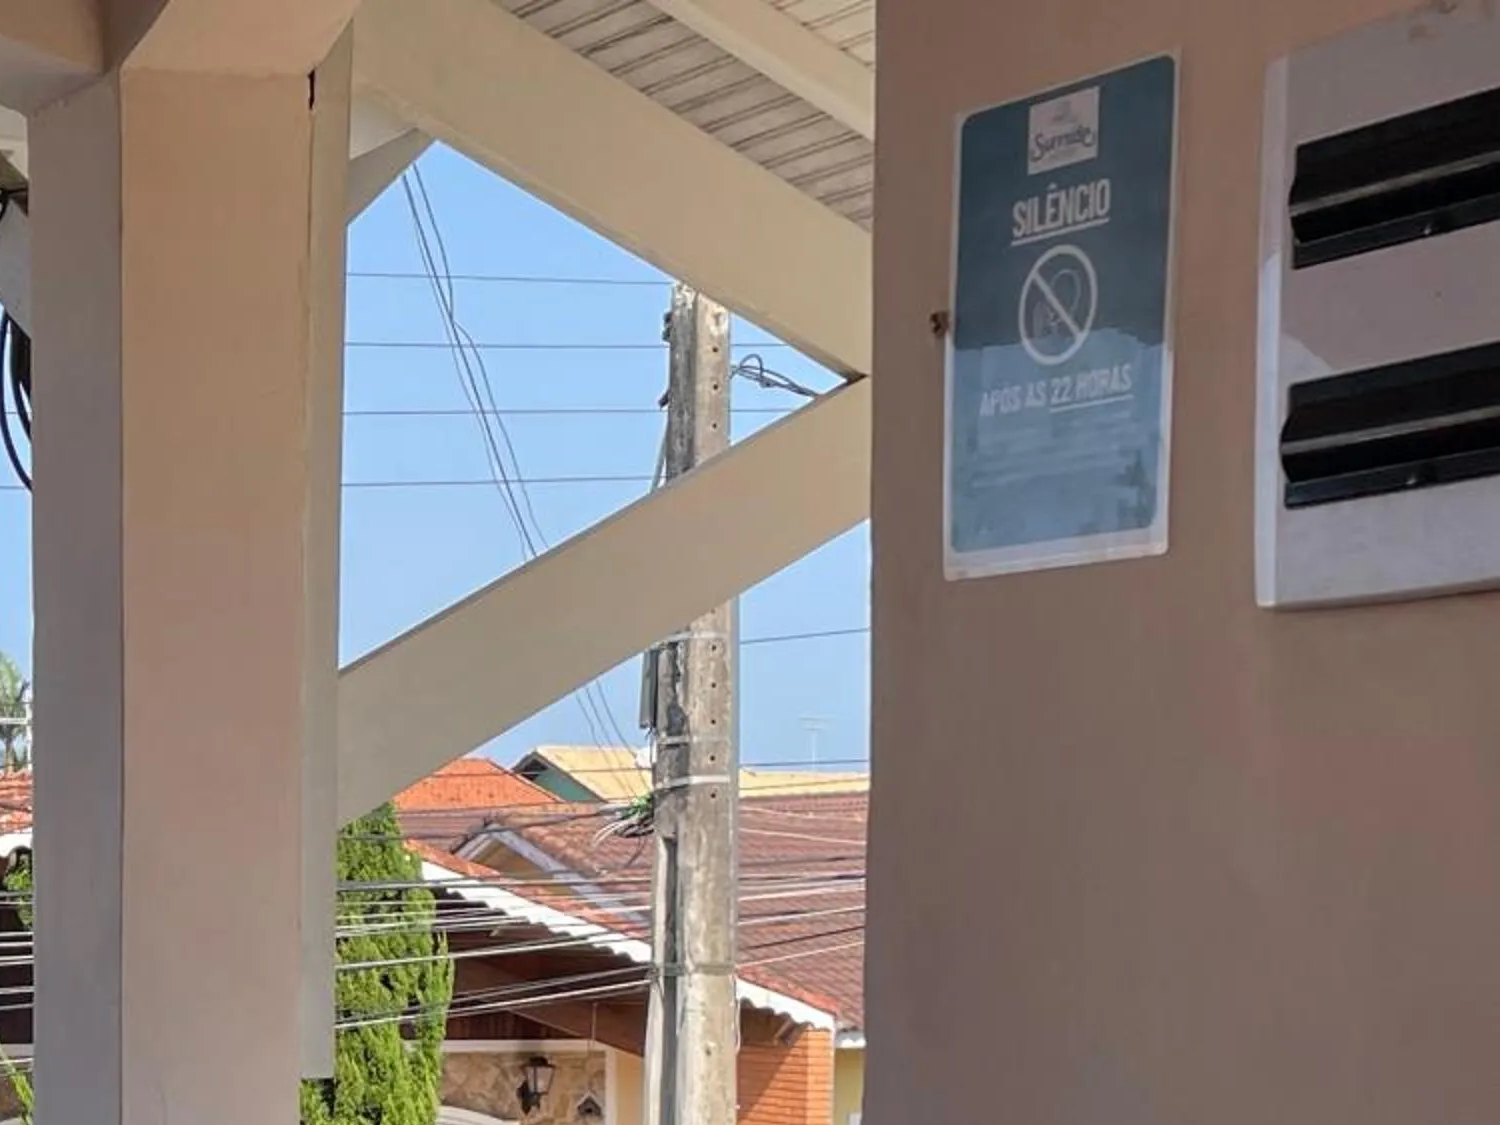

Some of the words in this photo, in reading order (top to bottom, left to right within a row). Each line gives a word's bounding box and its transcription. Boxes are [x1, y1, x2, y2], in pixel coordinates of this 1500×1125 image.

[1012, 178, 1110, 237] SILÊNCIO
[1049, 375, 1072, 405] 22
[1074, 364, 1133, 401] HORAS
